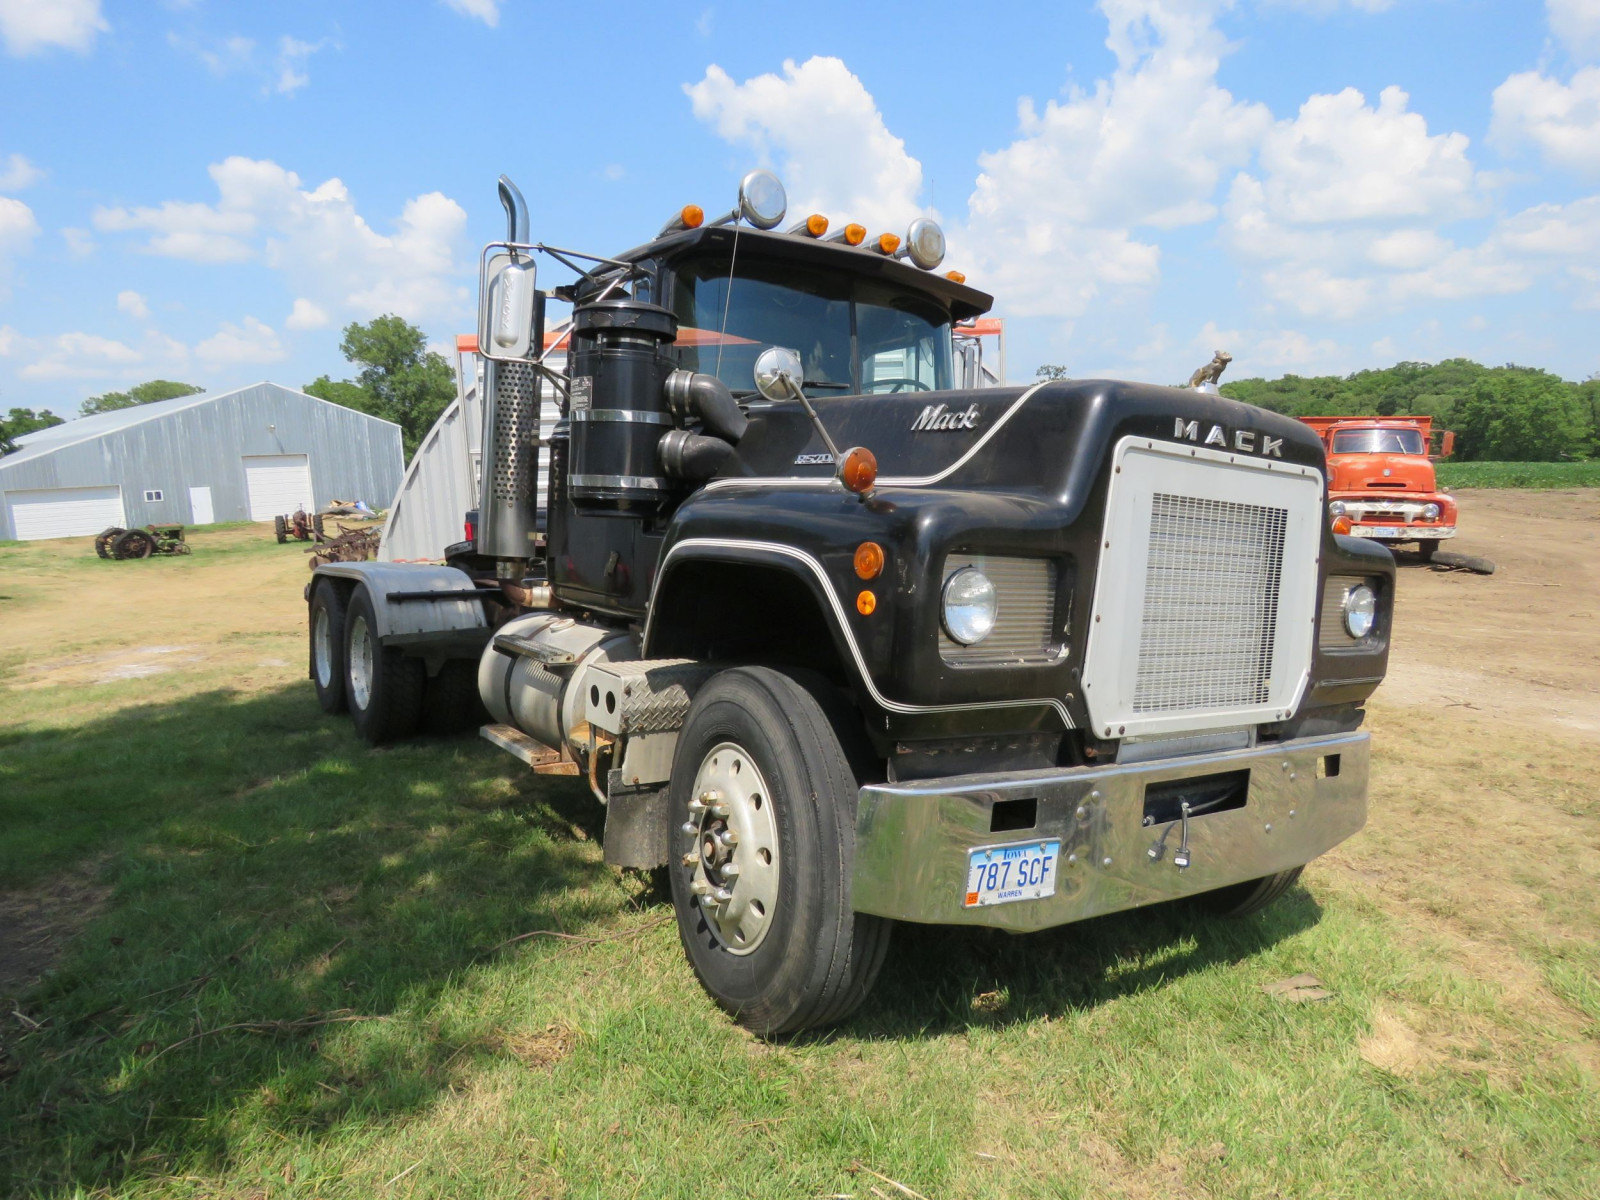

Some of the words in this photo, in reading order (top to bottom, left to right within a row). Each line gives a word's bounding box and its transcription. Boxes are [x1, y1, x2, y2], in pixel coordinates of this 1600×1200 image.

[910, 402, 980, 431] Mack
[1174, 417, 1283, 458] MACK
[977, 861, 1011, 892] 787
[1017, 855, 1052, 887] SCF
[997, 889, 1022, 899] WARREN
